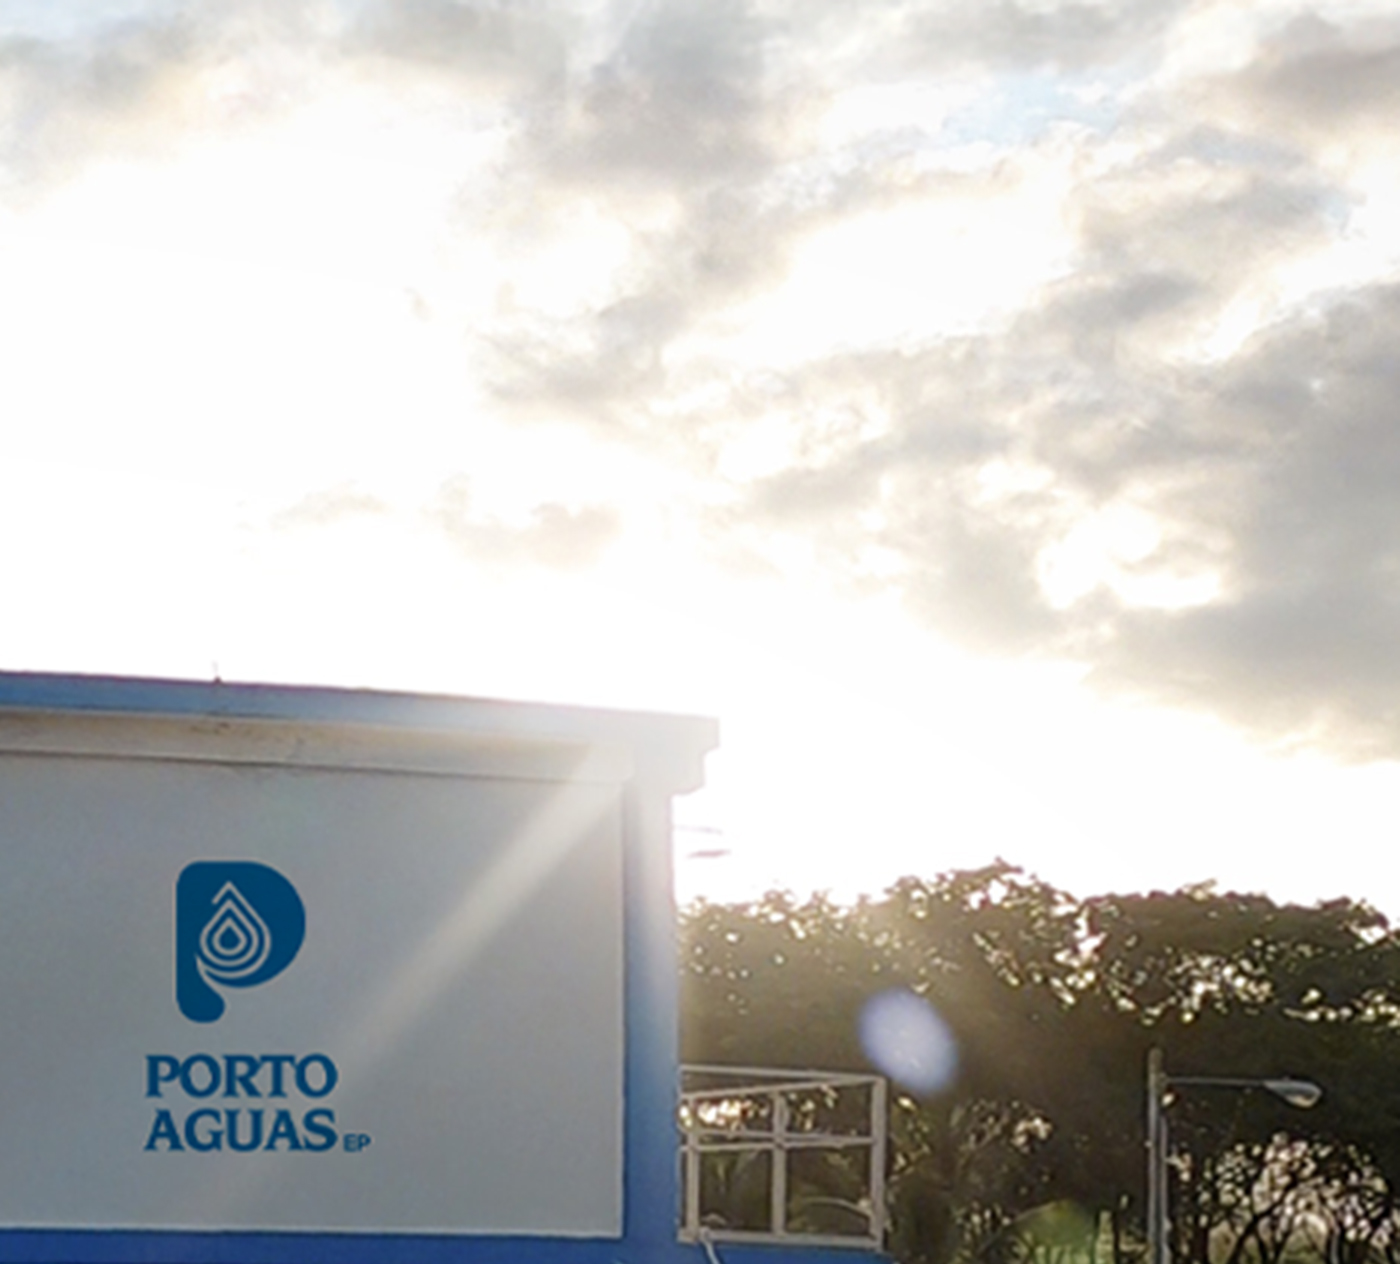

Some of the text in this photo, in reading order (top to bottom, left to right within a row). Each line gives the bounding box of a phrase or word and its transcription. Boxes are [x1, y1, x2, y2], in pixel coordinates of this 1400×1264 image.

[146, 1054, 337, 1098] PORTO
[145, 1108, 371, 1152] AGUAS EP
